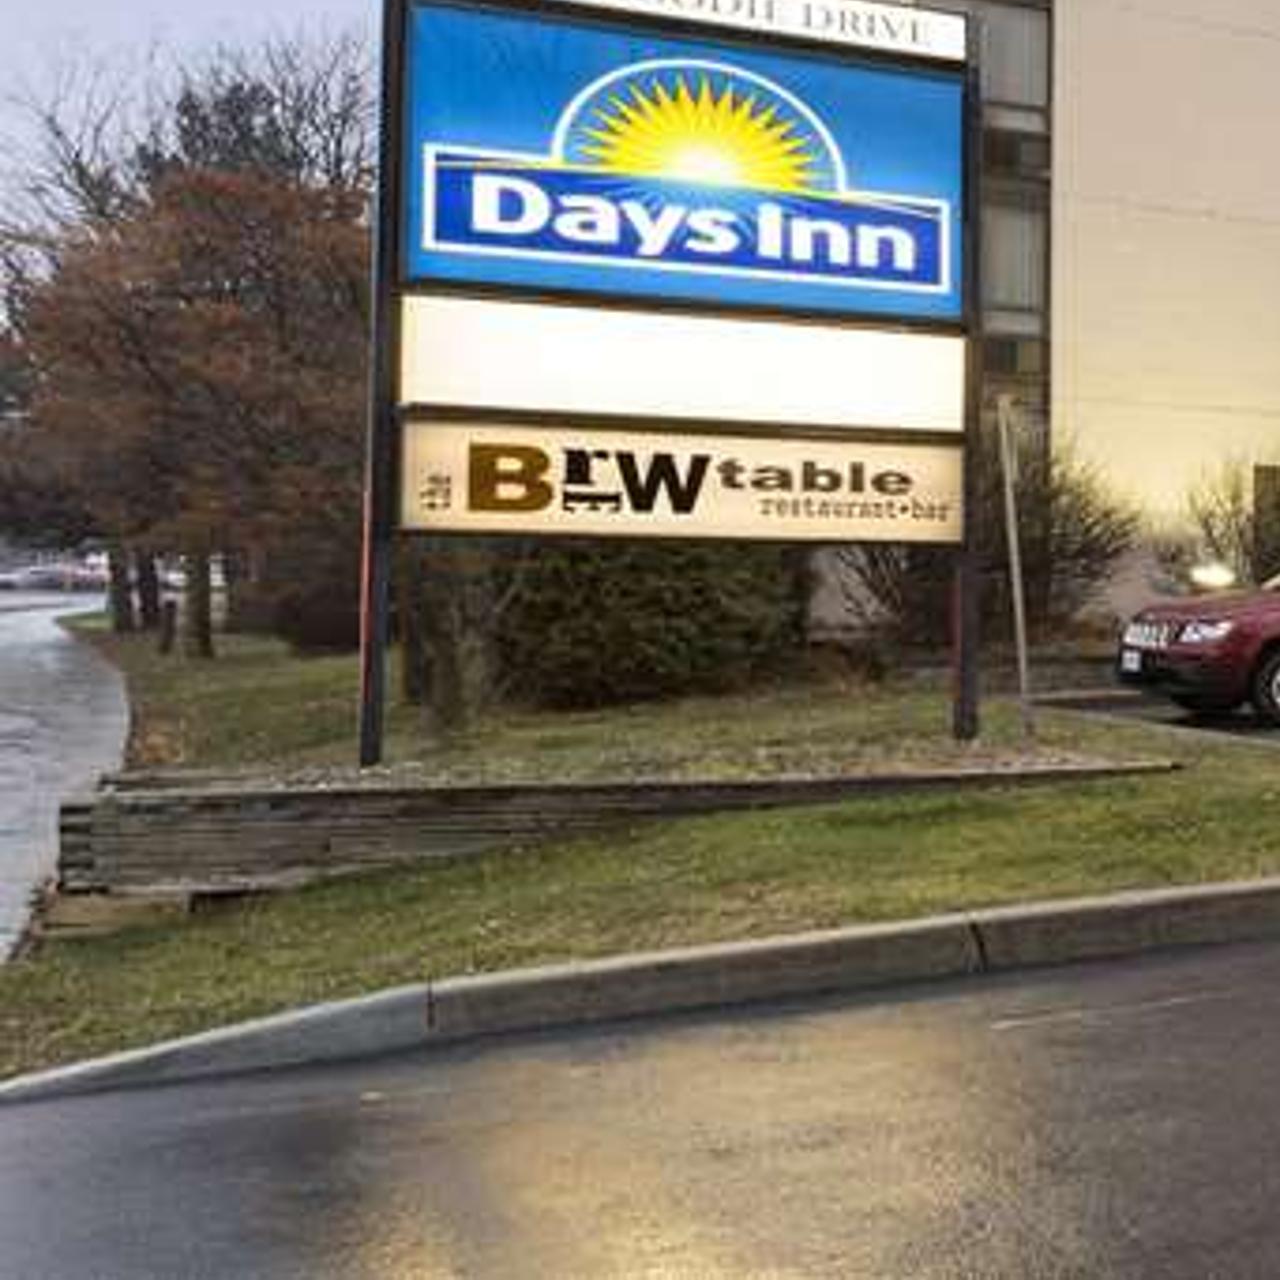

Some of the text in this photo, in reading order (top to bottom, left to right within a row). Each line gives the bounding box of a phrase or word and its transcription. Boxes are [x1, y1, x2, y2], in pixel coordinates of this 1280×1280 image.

[802, 1, 935, 47] DRIVE
[472, 173, 915, 271] Days Inn
[716, 458, 913, 496] table
